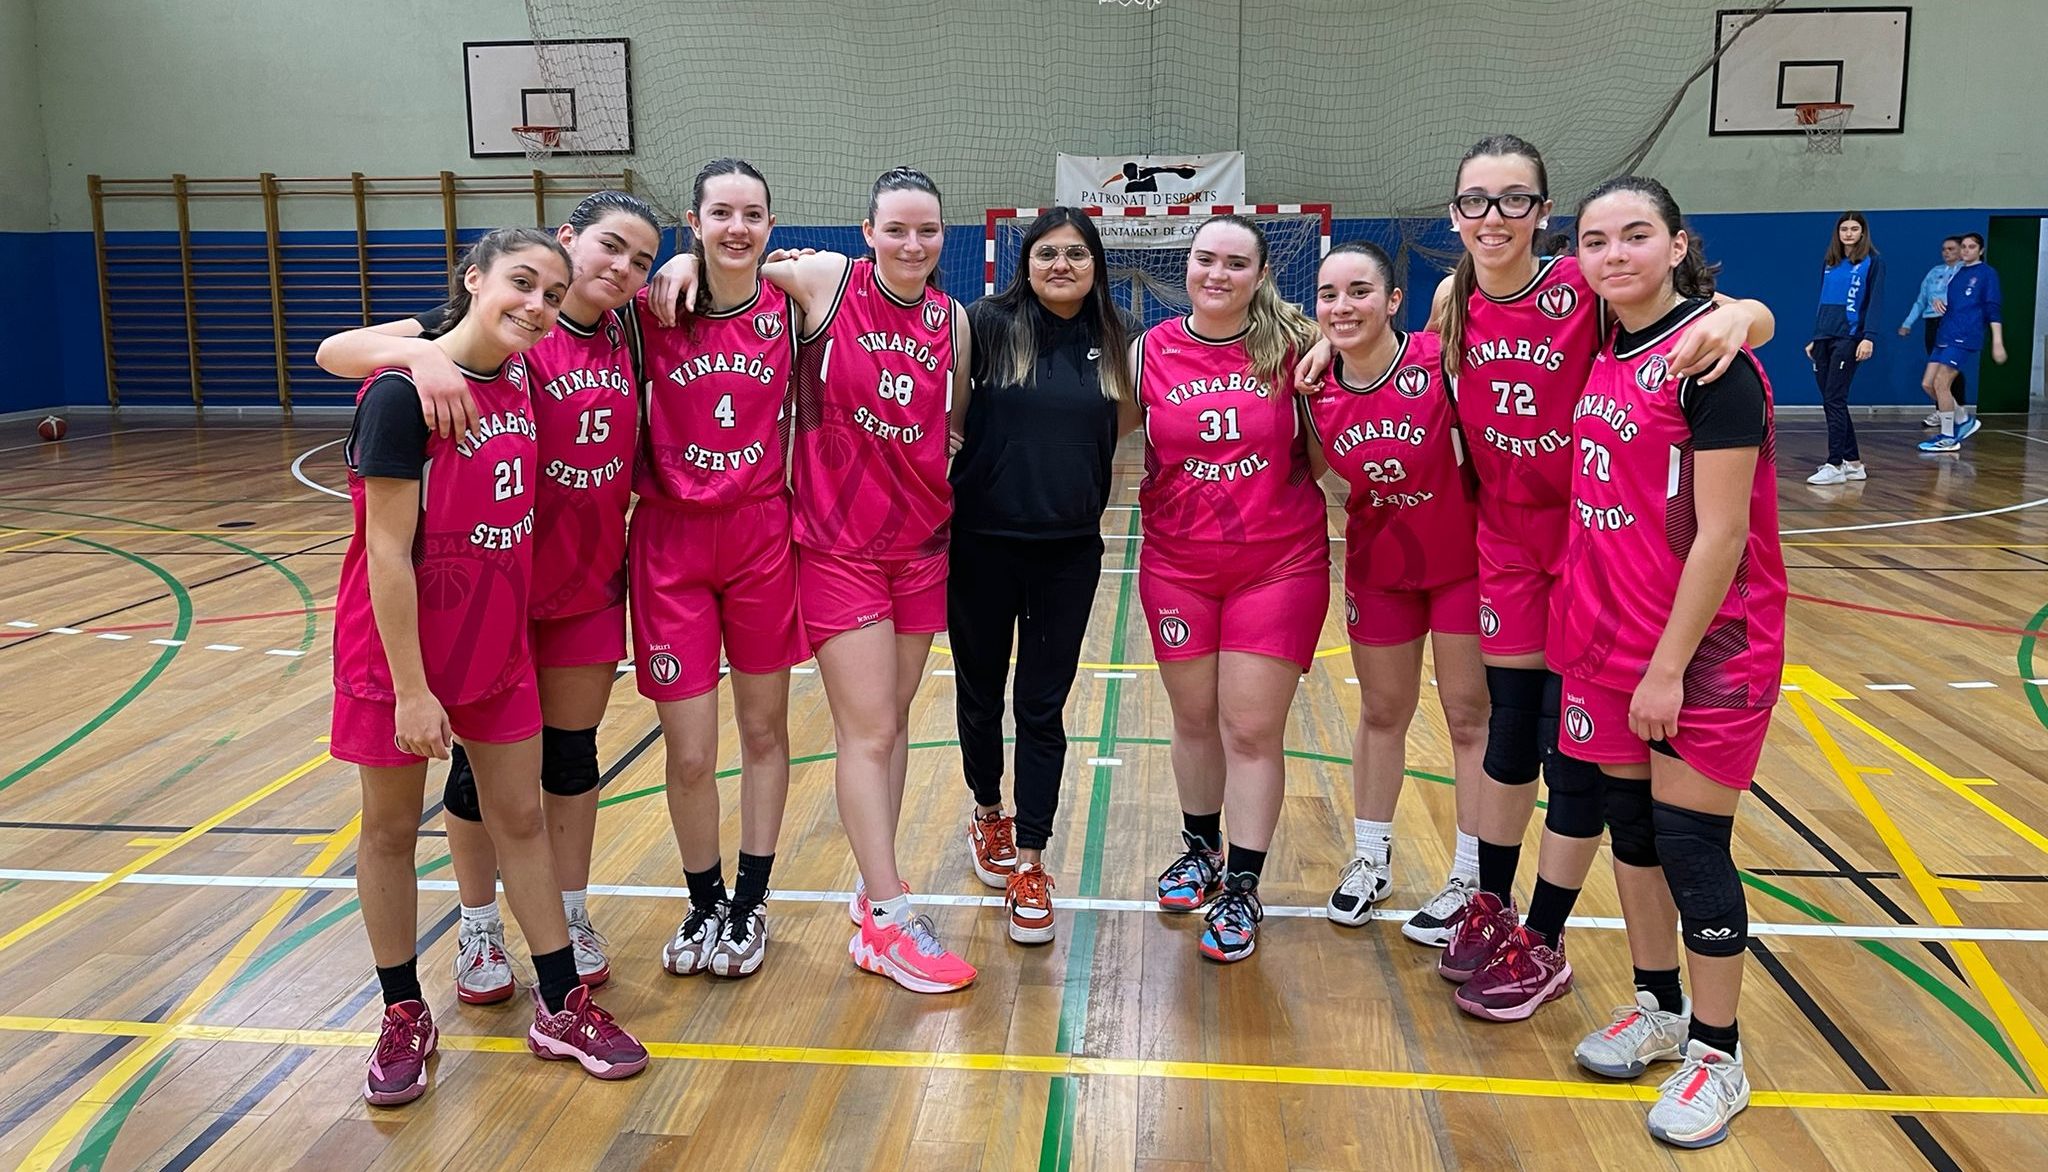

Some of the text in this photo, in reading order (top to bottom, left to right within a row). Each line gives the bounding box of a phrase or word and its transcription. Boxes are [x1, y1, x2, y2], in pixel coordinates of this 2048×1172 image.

[1080, 189, 1218, 206] PATRONAT D'ESPORTS
[1100, 225, 1201, 238] JUNTAMENT DE CAS
[857, 331, 940, 373] VINARÒS
[544, 366, 630, 402] VINARÒS
[668, 353, 775, 388] VINARÒS
[877, 368, 914, 407] 88
[713, 394, 736, 428] 4
[1491, 381, 1537, 416] 72
[575, 409, 613, 444] 15
[853, 405, 925, 445] SERVOL
[1199, 408, 1241, 442] 31
[1333, 415, 1427, 458] VINARÒS
[1484, 426, 1572, 458] SERVOL
[545, 456, 625, 490] SERVOL
[1183, 453, 1270, 482] SERVOL
[1363, 458, 1407, 484] 23
[1580, 438, 1611, 482] 70
[494, 457, 525, 501] 21
[1576, 498, 1635, 531] RVOL
